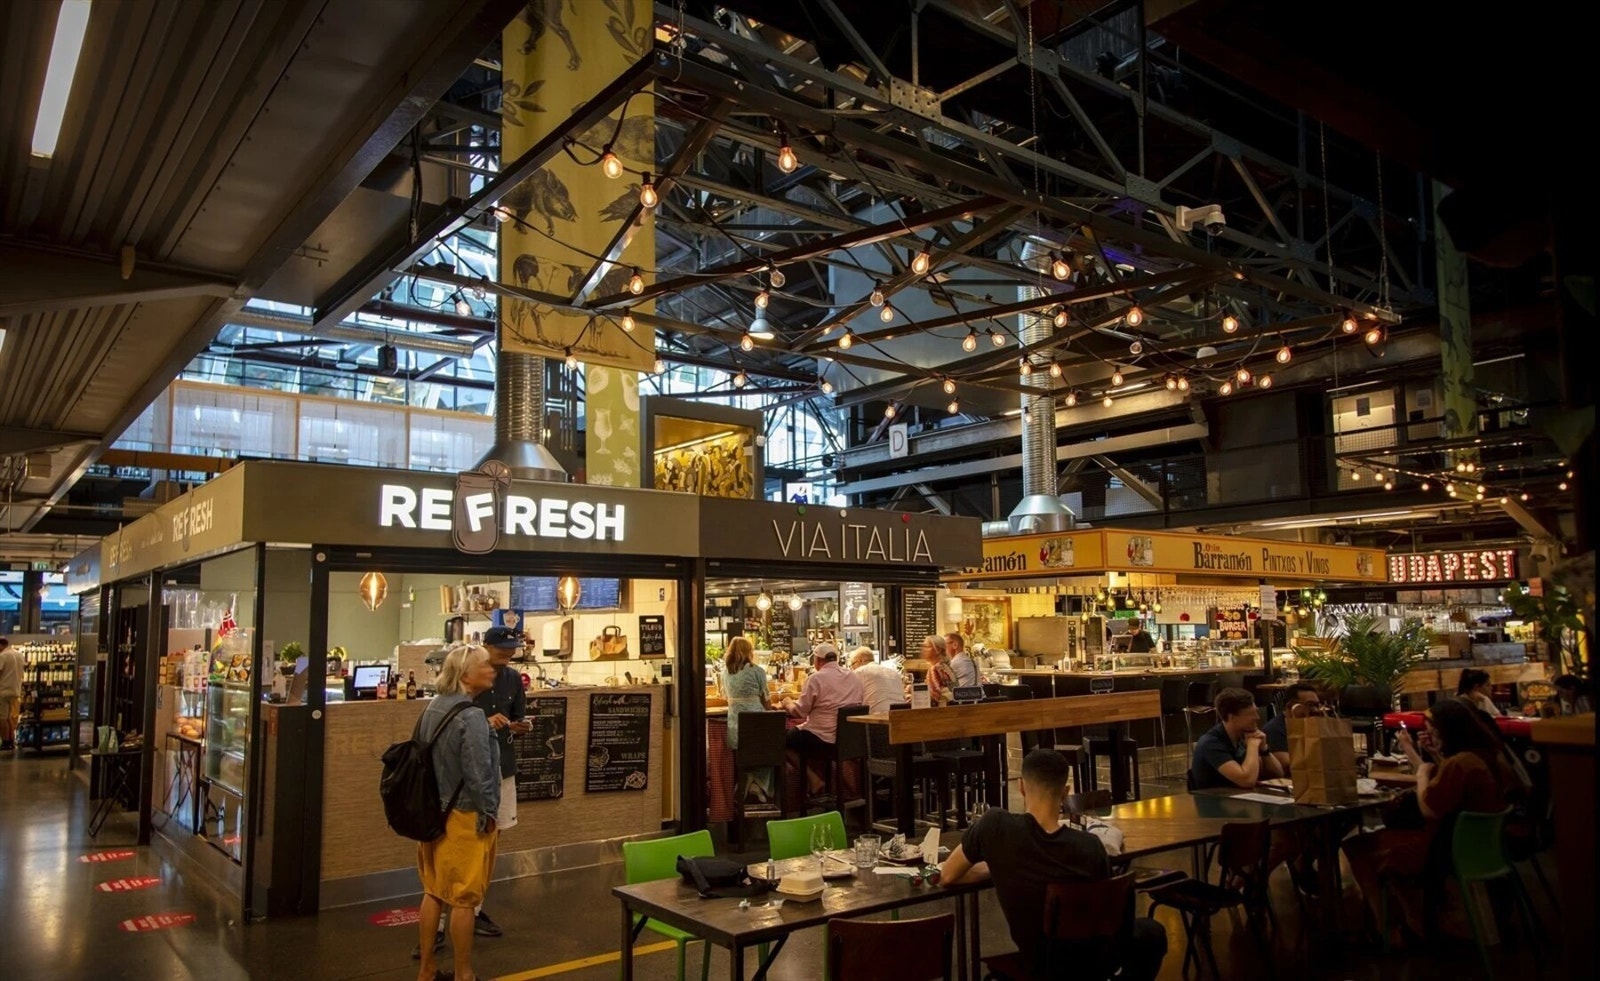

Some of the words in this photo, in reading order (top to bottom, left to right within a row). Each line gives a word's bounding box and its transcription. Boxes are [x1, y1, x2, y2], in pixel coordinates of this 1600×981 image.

[893, 430, 905, 452] D
[172, 497, 214, 543] REFRESH
[379, 484, 626, 542] REFRESH
[772, 519, 832, 559] VIA
[840, 522, 933, 563] ITALIA
[1192, 541, 1252, 571] Barramón
[962, 550, 1027, 573] amón
[1390, 549, 1515, 583] UDAPEST
[1220, 621, 1247, 632] BURGER
[621, 752, 646, 760] WRAPS
